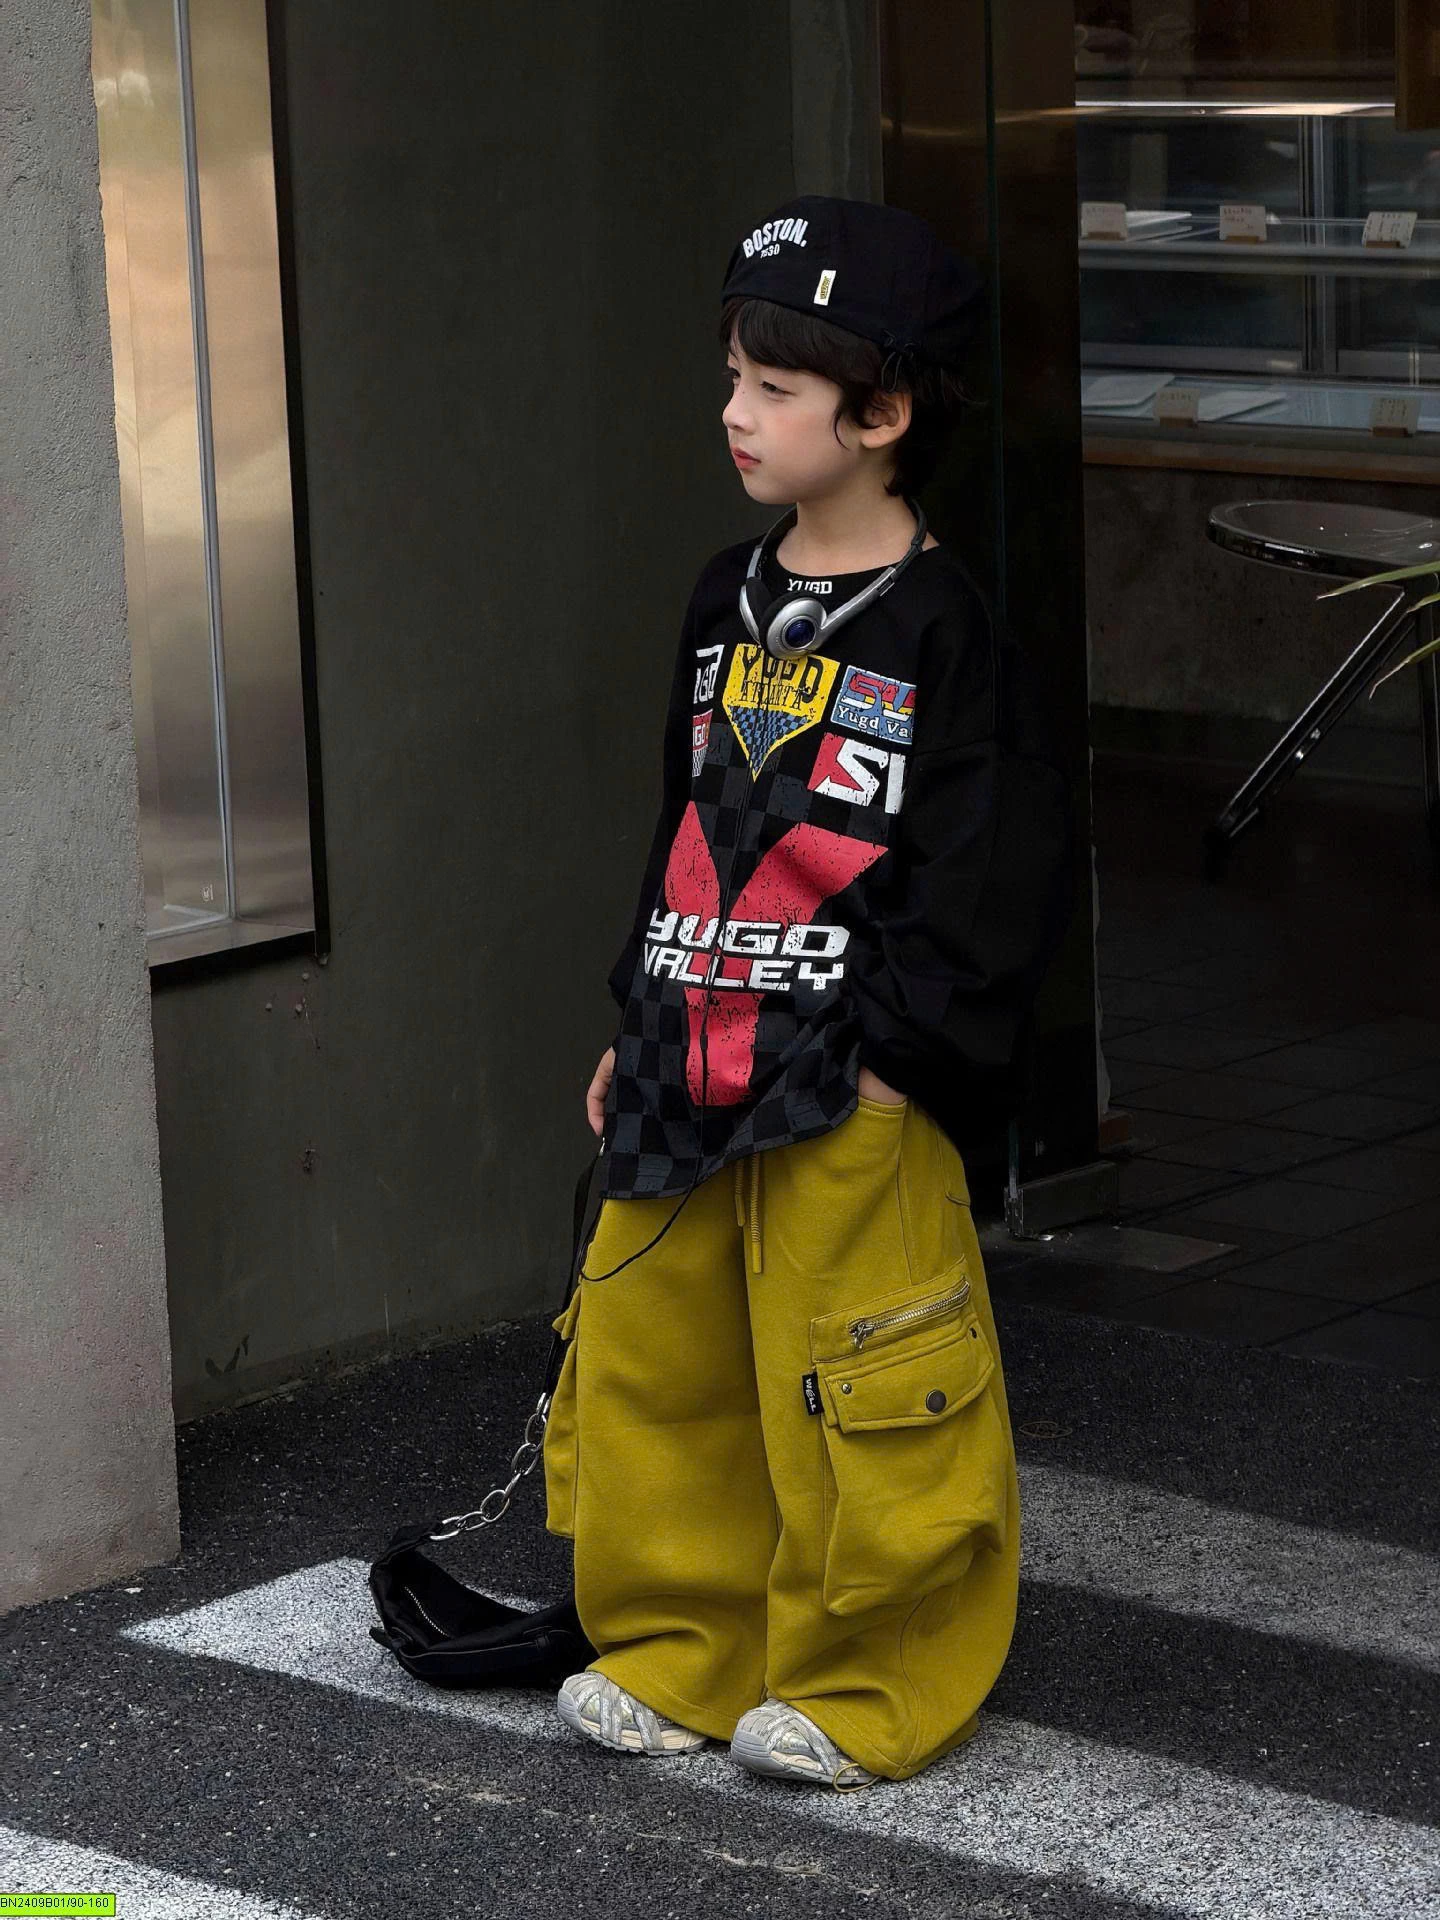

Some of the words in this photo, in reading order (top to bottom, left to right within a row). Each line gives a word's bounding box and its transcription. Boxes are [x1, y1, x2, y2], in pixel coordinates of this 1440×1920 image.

[742, 218, 809, 258] BOSTON.
[787, 578, 833, 595] YUGD
[838, 705, 880, 730] Yugd
[646, 907, 850, 958] YUGD
[644, 942, 844, 992] VALLEY
